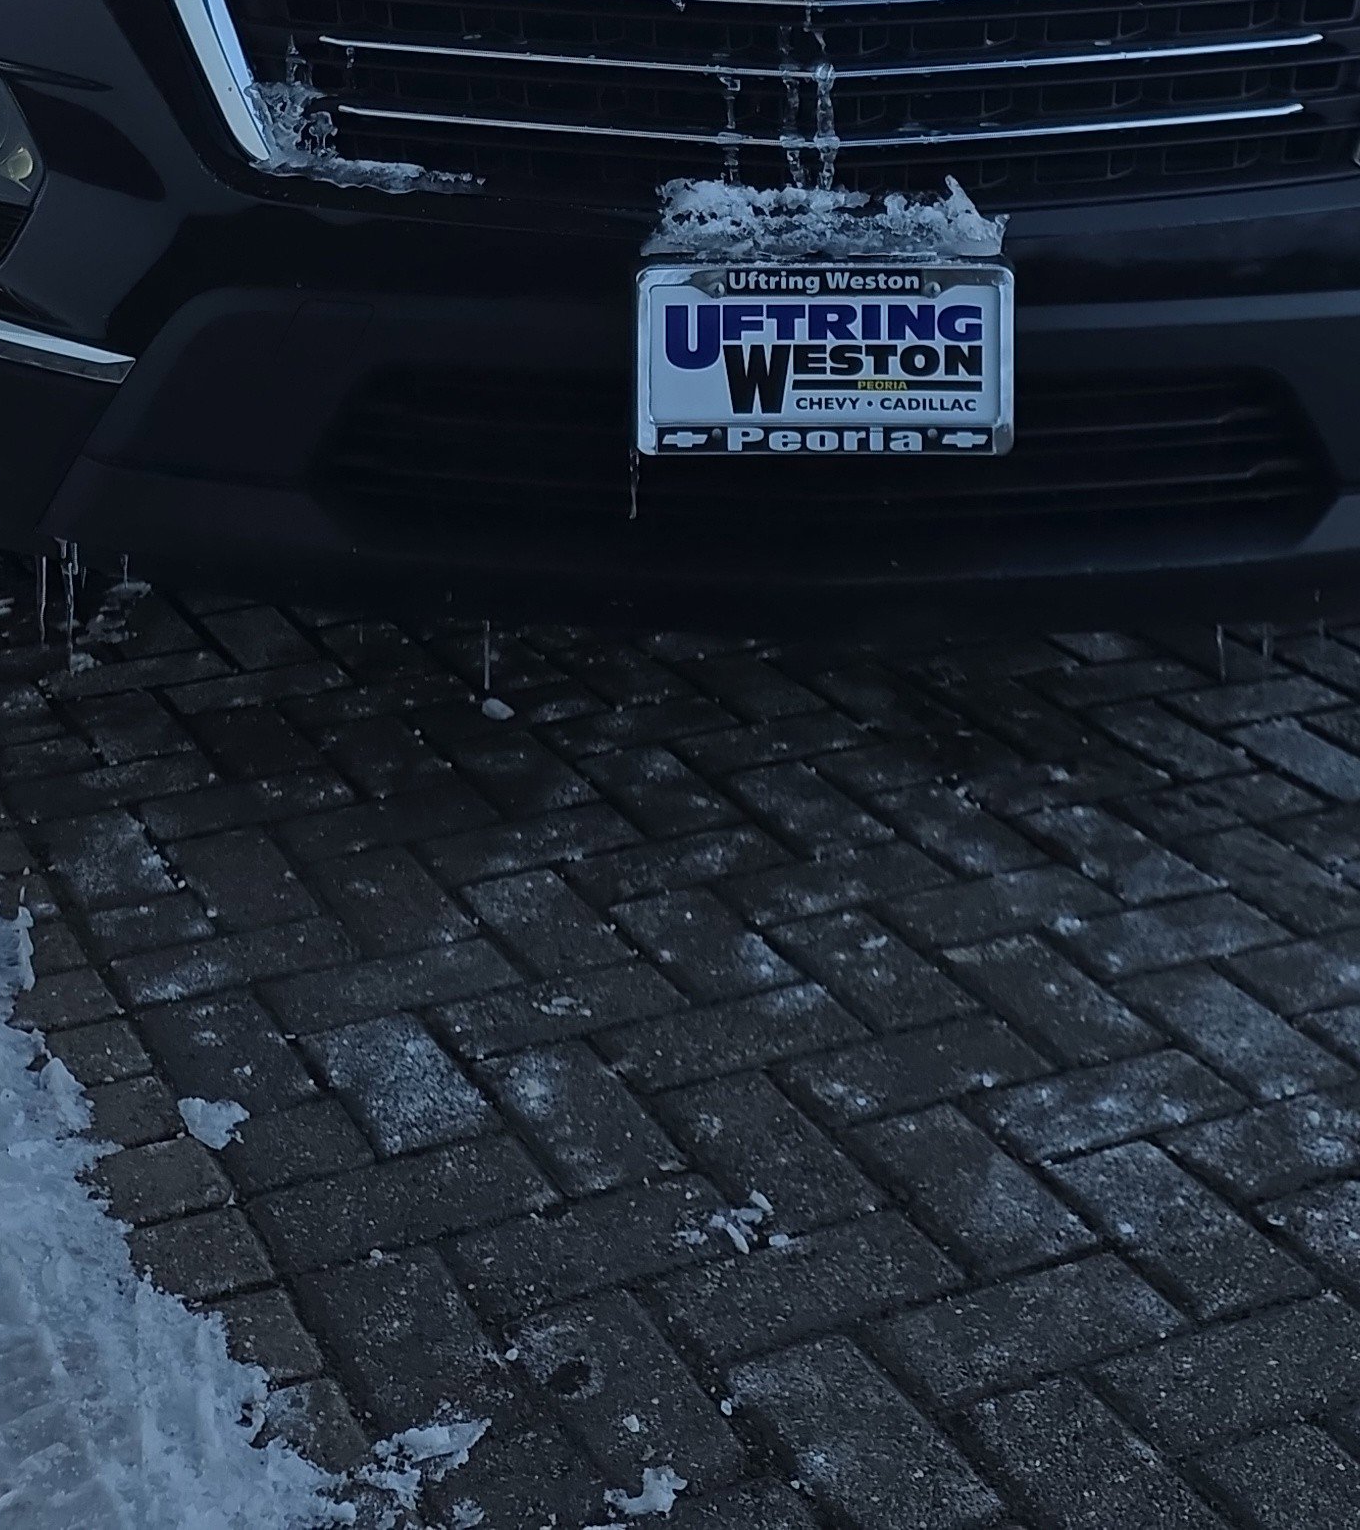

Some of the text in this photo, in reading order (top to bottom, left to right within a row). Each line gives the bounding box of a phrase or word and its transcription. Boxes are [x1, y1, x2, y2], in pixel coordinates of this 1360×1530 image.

[728, 271, 920, 294] Uftring Weston
[665, 304, 983, 370] UFTRING
[722, 344, 984, 415] WESTON
[856, 380, 908, 391] PEORIA
[795, 397, 977, 412] CHEVY CADILLAC
[726, 426, 923, 452] Peoria
